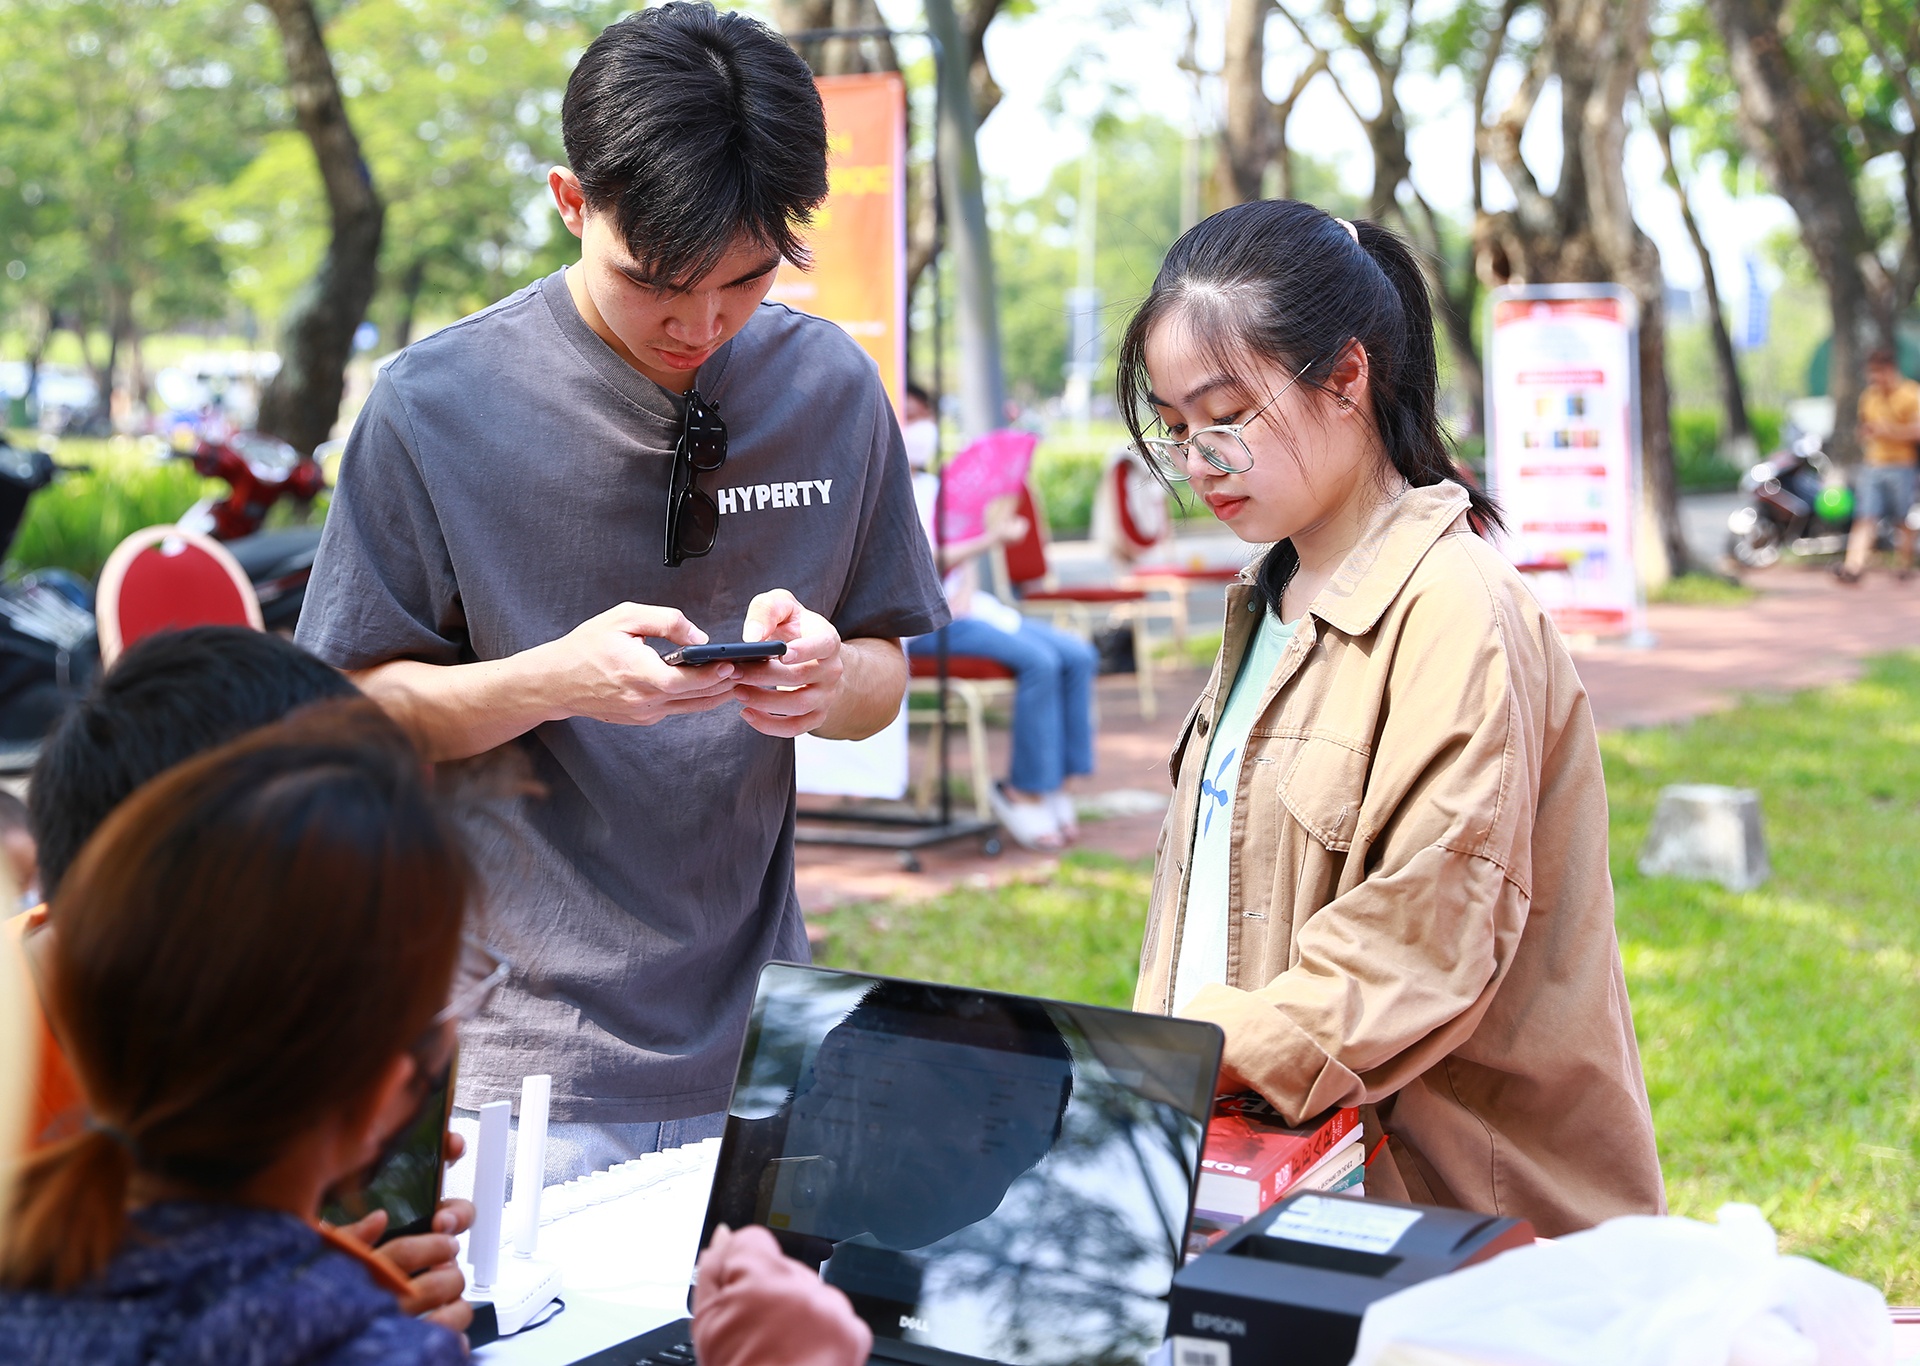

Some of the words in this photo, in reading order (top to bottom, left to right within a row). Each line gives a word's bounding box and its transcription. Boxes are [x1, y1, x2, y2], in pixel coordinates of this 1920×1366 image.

[718, 479, 832, 514] HYPERTY
[1201, 1160, 1251, 1175] BOB
[899, 1315, 928, 1331] DELL
[1191, 1312, 1246, 1336] EPSON
